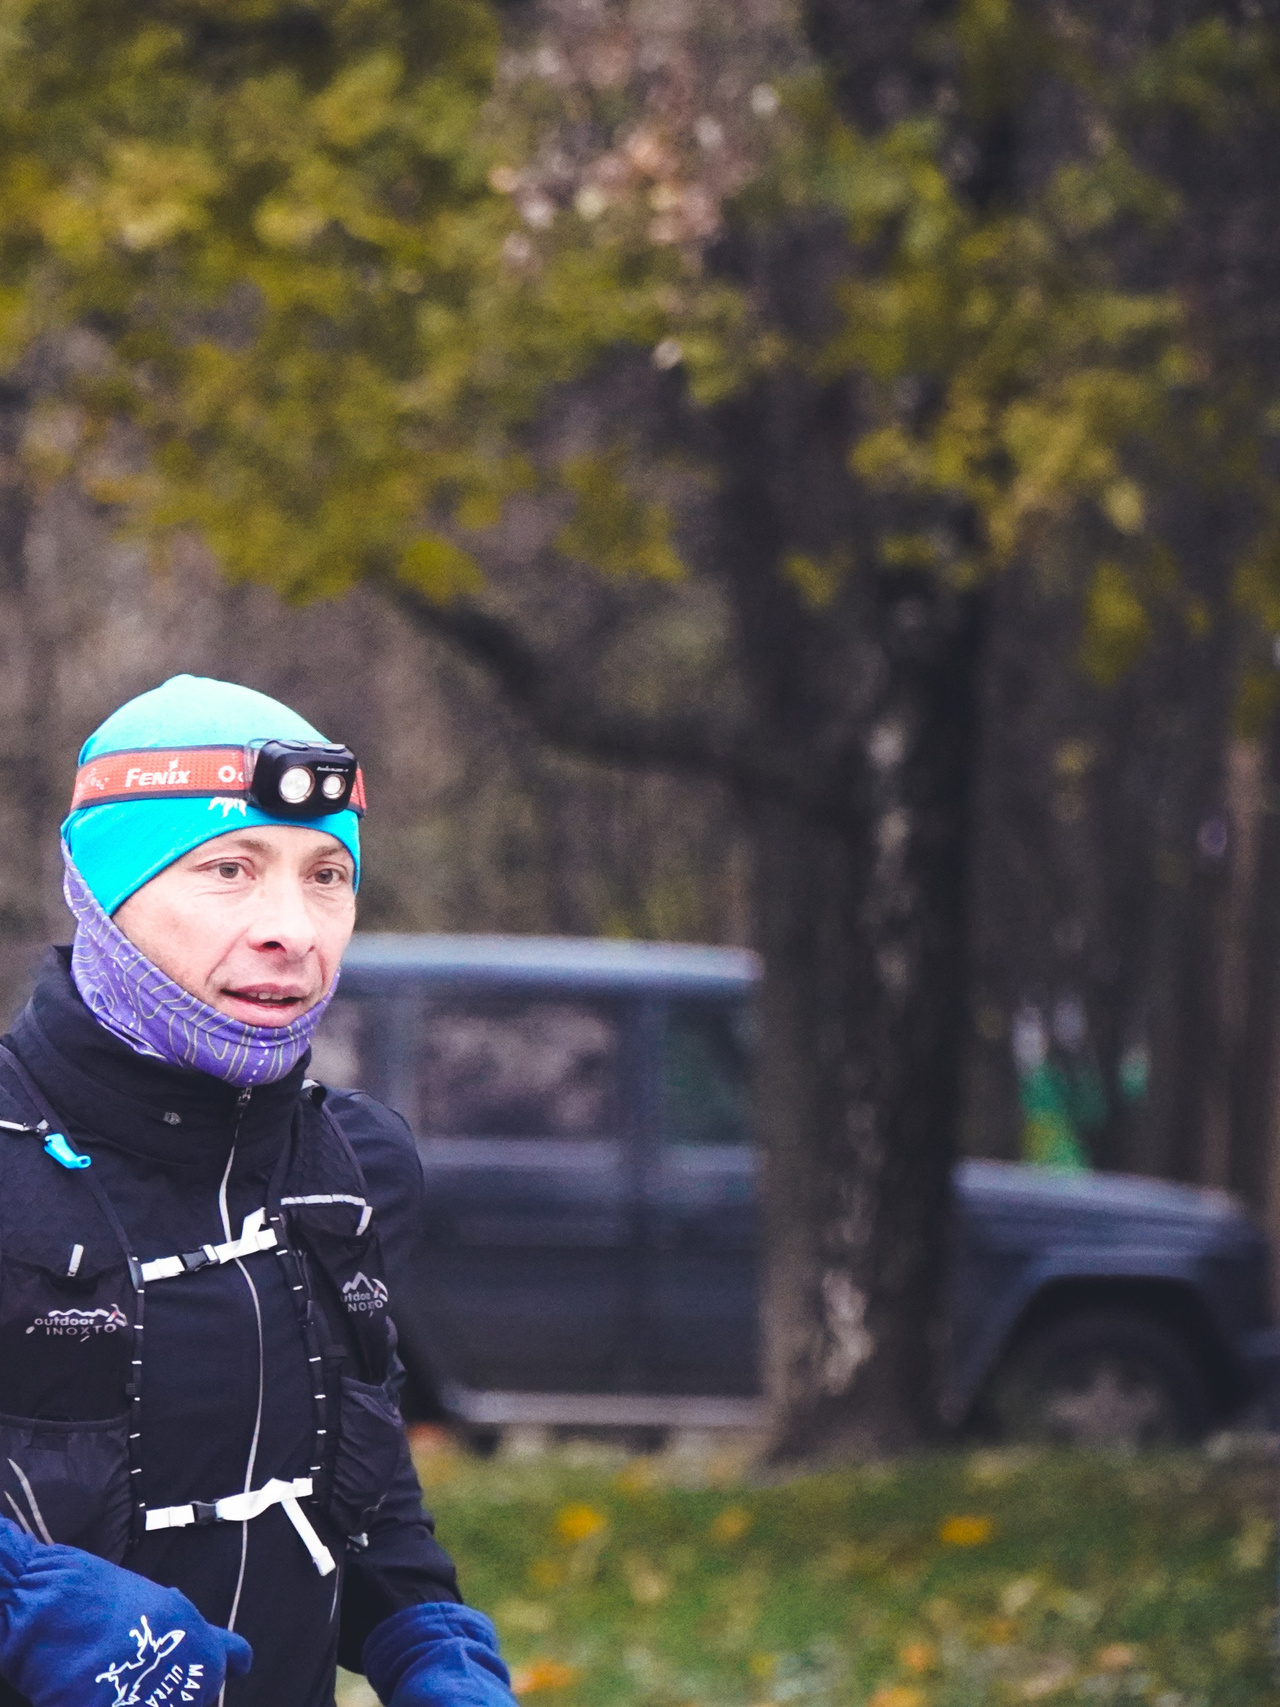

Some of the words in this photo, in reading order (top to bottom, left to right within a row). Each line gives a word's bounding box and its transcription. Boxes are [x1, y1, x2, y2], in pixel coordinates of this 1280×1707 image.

[34, 1316, 95, 1327] outdoor
[45, 1323, 117, 1336] INOXTO
[144, 1664, 183, 1707] ULTRA
[180, 1664, 204, 1702] MAD
